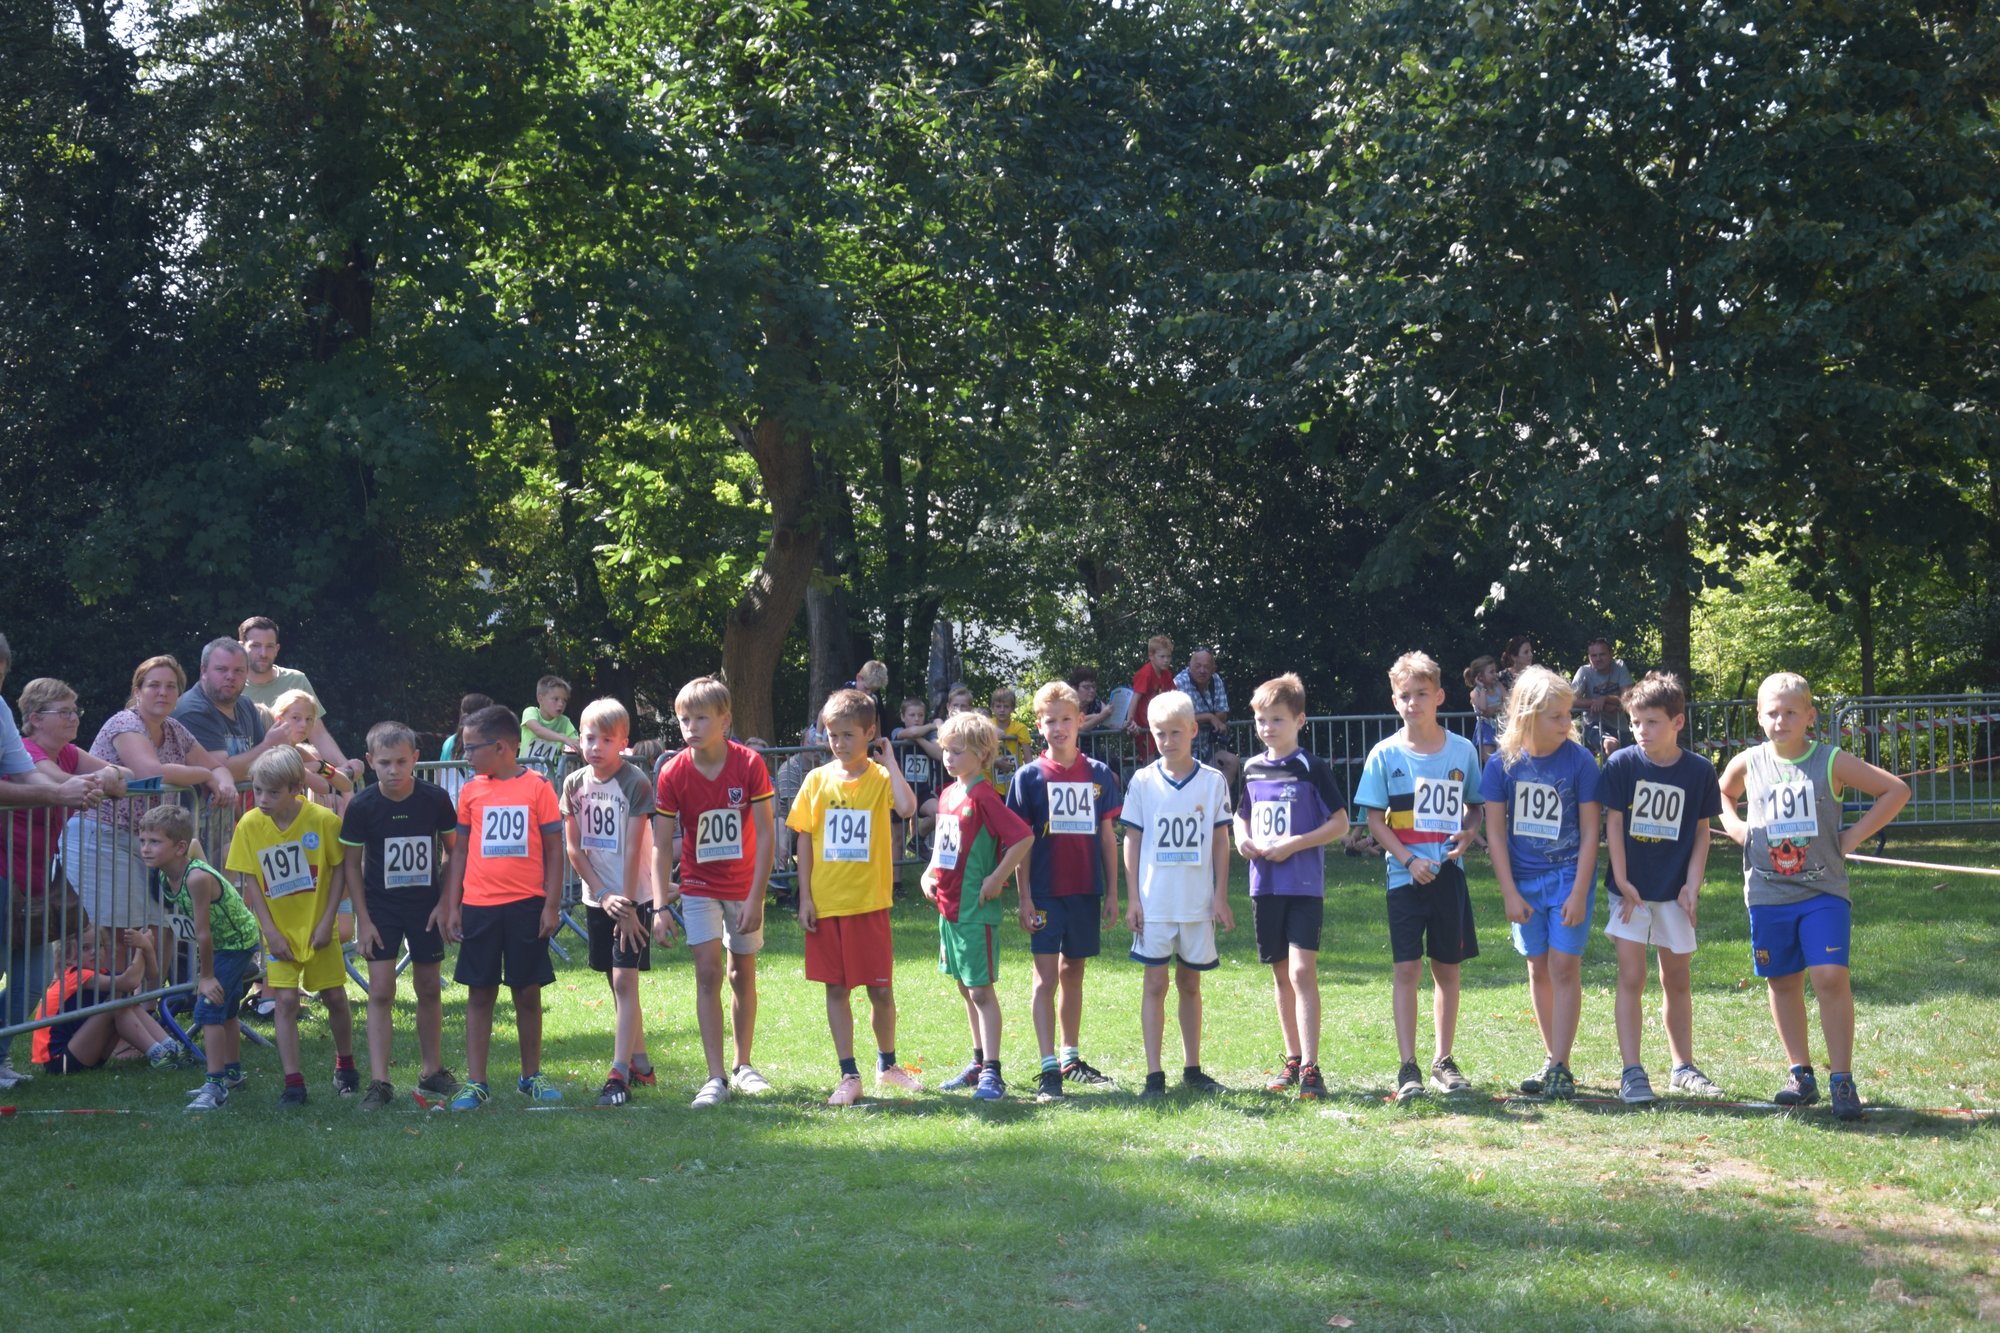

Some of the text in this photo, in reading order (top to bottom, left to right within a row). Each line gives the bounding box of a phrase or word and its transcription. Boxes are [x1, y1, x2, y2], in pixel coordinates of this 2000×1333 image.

[1052, 787, 1092, 816] 204
[1417, 783, 1459, 816] 205
[1519, 786, 1559, 821] 192
[1635, 786, 1681, 822] 200
[1767, 785, 1808, 820] 191
[485, 811, 524, 841] 209
[584, 804, 616, 836] 198
[699, 813, 738, 845] 206
[829, 814, 867, 844] 194
[1157, 817, 1199, 848] 202
[1254, 806, 1286, 836] 196
[263, 844, 300, 881] 197
[388, 842, 428, 872] 208
[173, 917, 198, 940] 20
